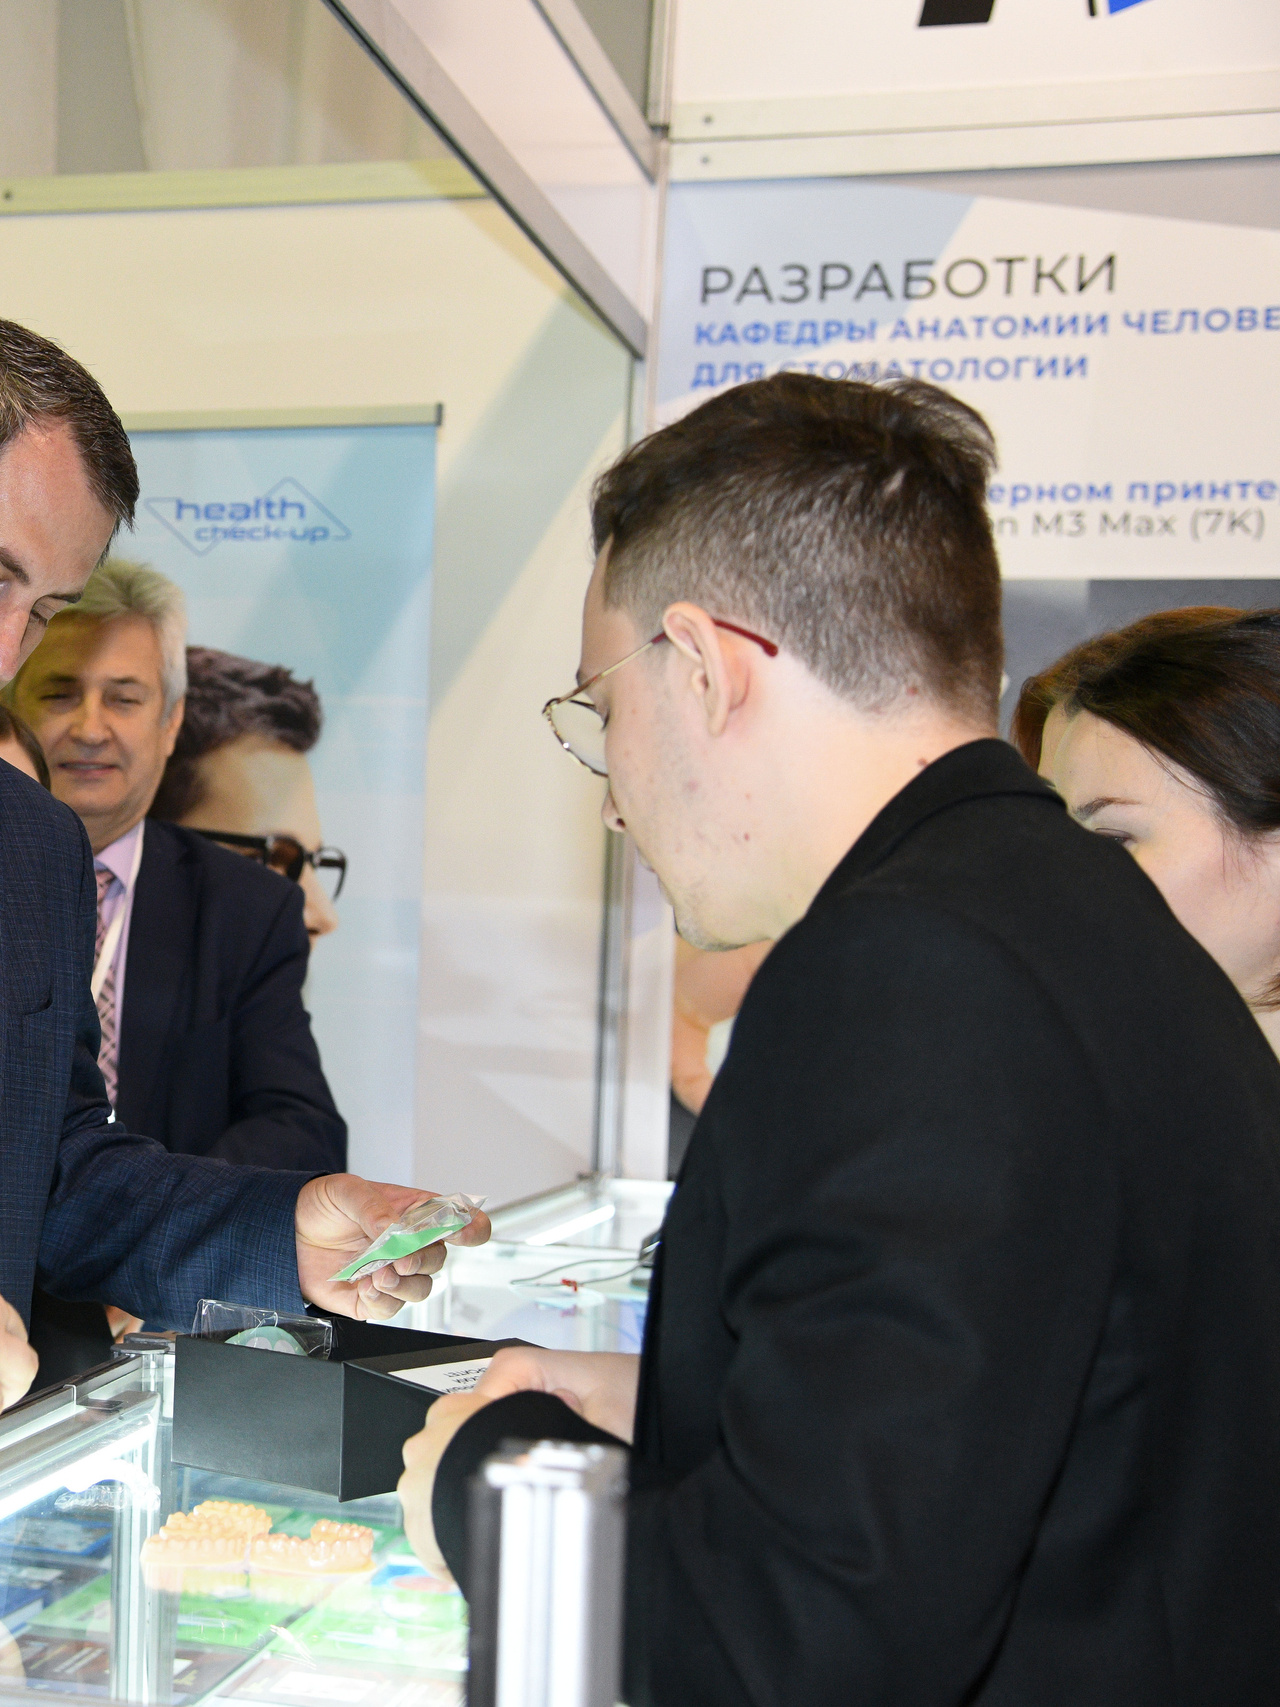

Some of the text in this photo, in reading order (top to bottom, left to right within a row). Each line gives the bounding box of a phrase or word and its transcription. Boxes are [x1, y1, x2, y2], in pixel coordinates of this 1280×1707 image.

[699, 252, 1116, 306] РАЗРАБОТКИ
[693, 317, 877, 347] КАФЕДРЫ
[889, 311, 1110, 343] АНАТОМИИ
[689, 361, 765, 390] ДЛЯ
[176, 497, 306, 521] health
[1031, 509, 1086, 537] M3
[1098, 511, 1176, 537] Max
[1189, 507, 1266, 541] (7K)
[195, 524, 330, 543] check-up
